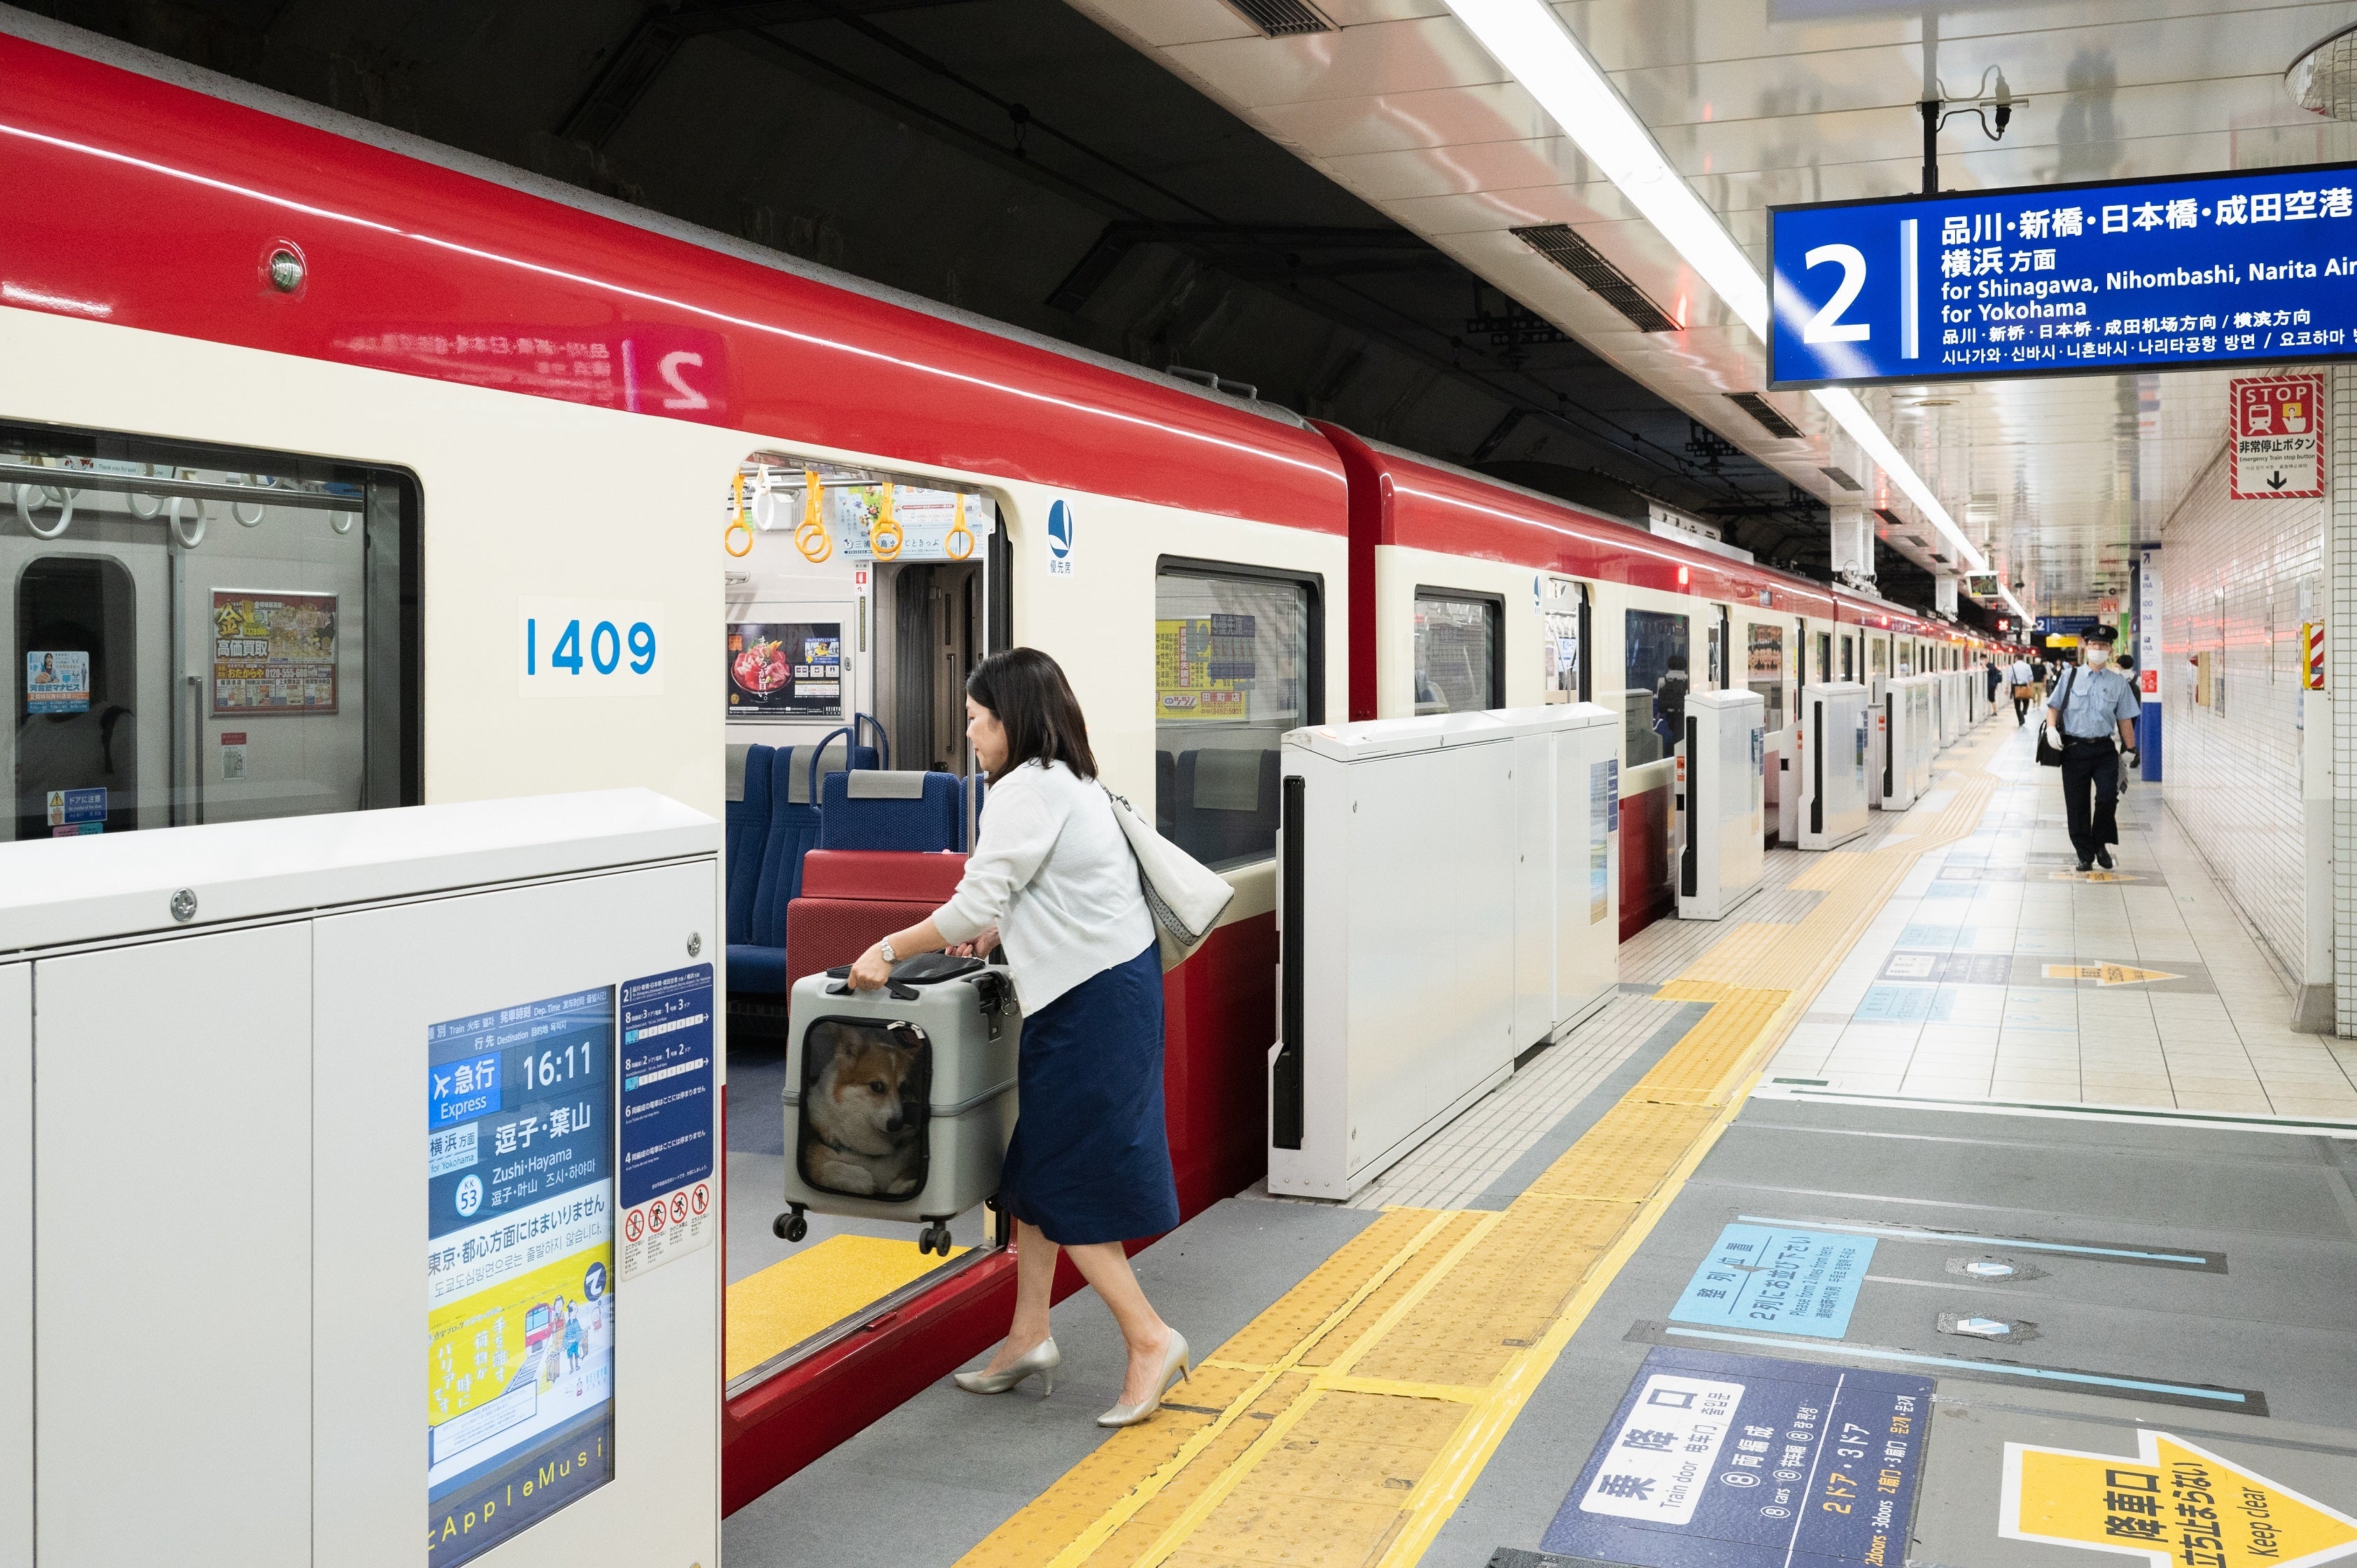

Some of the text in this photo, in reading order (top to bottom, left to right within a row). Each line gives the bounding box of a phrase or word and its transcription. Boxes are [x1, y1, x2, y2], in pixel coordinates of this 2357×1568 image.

[1942, 187, 2353, 245] 品川・新橋・日本橋・成田空港
[1941, 246, 2057, 279] 横浜 方面
[1941, 282, 1971, 300] for
[1978, 278, 2099, 300] Shinagawa,
[2106, 263, 2241, 290] Nihombashi,
[2248, 260, 2317, 281] Narita
[1803, 244, 1870, 344] 2
[1941, 300, 2087, 323] for Yokohama
[2233, 309, 2311, 328] 横滨方向
[2224, 333, 2255, 351] 방면
[2279, 329, 2345, 347] 요코하마
[2246, 386, 2307, 403] STOP
[2239, 438, 2316, 454] 非常停止ボタン
[1050, 559, 1071, 574] 優先席
[217, 640, 268, 657] 高価買取
[528, 619, 656, 675] 1409
[228, 668, 265, 678] おたからや
[1202, 692, 1241, 702] 田町店
[69, 794, 101, 804] ドアに注意
[623, 988, 629, 1002] 2
[501, 1006, 530, 1023] 発車時刻
[534, 1002, 559, 1017] Dep. Time
[449, 1023, 464, 1035] Train
[467, 1020, 480, 1031] 火车
[498, 1030, 528, 1045] Destination
[454, 1058, 494, 1096] 急行
[524, 1041, 589, 1091] 16:11
[441, 1093, 487, 1122] Express
[495, 1100, 589, 1156] 逗子・葉山
[431, 1132, 474, 1157] 横浜 方面
[431, 1153, 473, 1173] for Yokohama
[461, 1189, 476, 1210] 53
[527, 1236, 561, 1262] 출발하지
[566, 1223, 602, 1246] 않습니다.
[1694, 1242, 1754, 1299] 整列位置
[1810, 1256, 1828, 1268] from
[1746, 1235, 1814, 1320] 2列にお並び下さい
[1805, 1268, 1824, 1280] lines
[1798, 1284, 1816, 1298] form
[1789, 1298, 1811, 1316] Please
[475, 1331, 488, 1380] 荷物が
[493, 1316, 506, 1382] 手を離す
[457, 1373, 470, 1408] 時に
[1699, 1392, 1731, 1415] 출입문
[1796, 1406, 1819, 1420] 편성
[1593, 1386, 1699, 1501] 乗降口
[1682, 1424, 1718, 1452] 电车门
[1730, 1424, 1775, 1467] 両編成
[1659, 1460, 1700, 1508] Train door
[1771, 1488, 1791, 1504] cars
[2103, 1469, 2168, 1542] 降車口
[1871, 1500, 1895, 1527] 3doors
[2237, 1487, 2281, 1558] Keep clear
